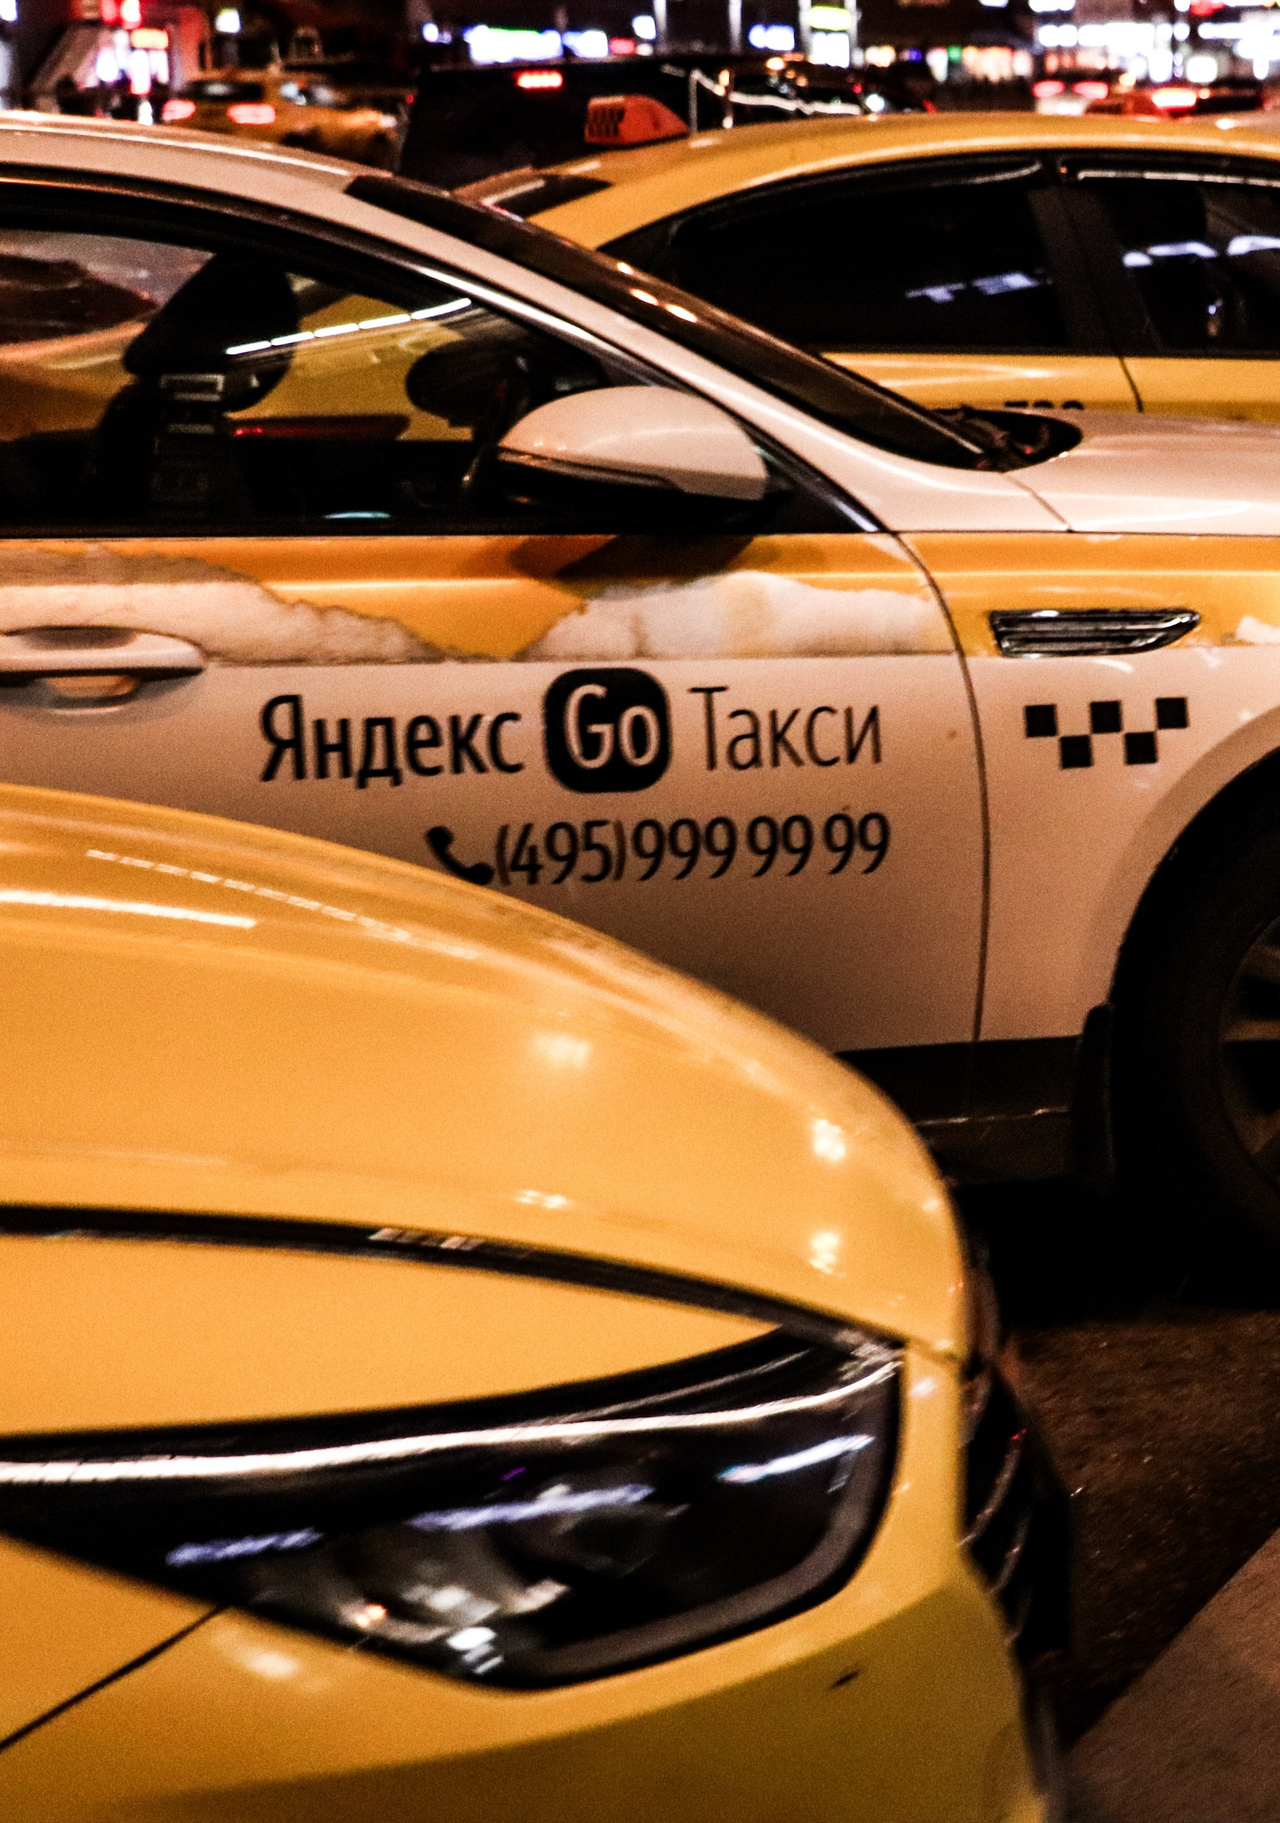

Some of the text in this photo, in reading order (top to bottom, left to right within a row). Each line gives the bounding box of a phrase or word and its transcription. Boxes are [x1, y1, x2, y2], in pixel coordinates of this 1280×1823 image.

[260, 683, 882, 789] Яндекс Go Такси
